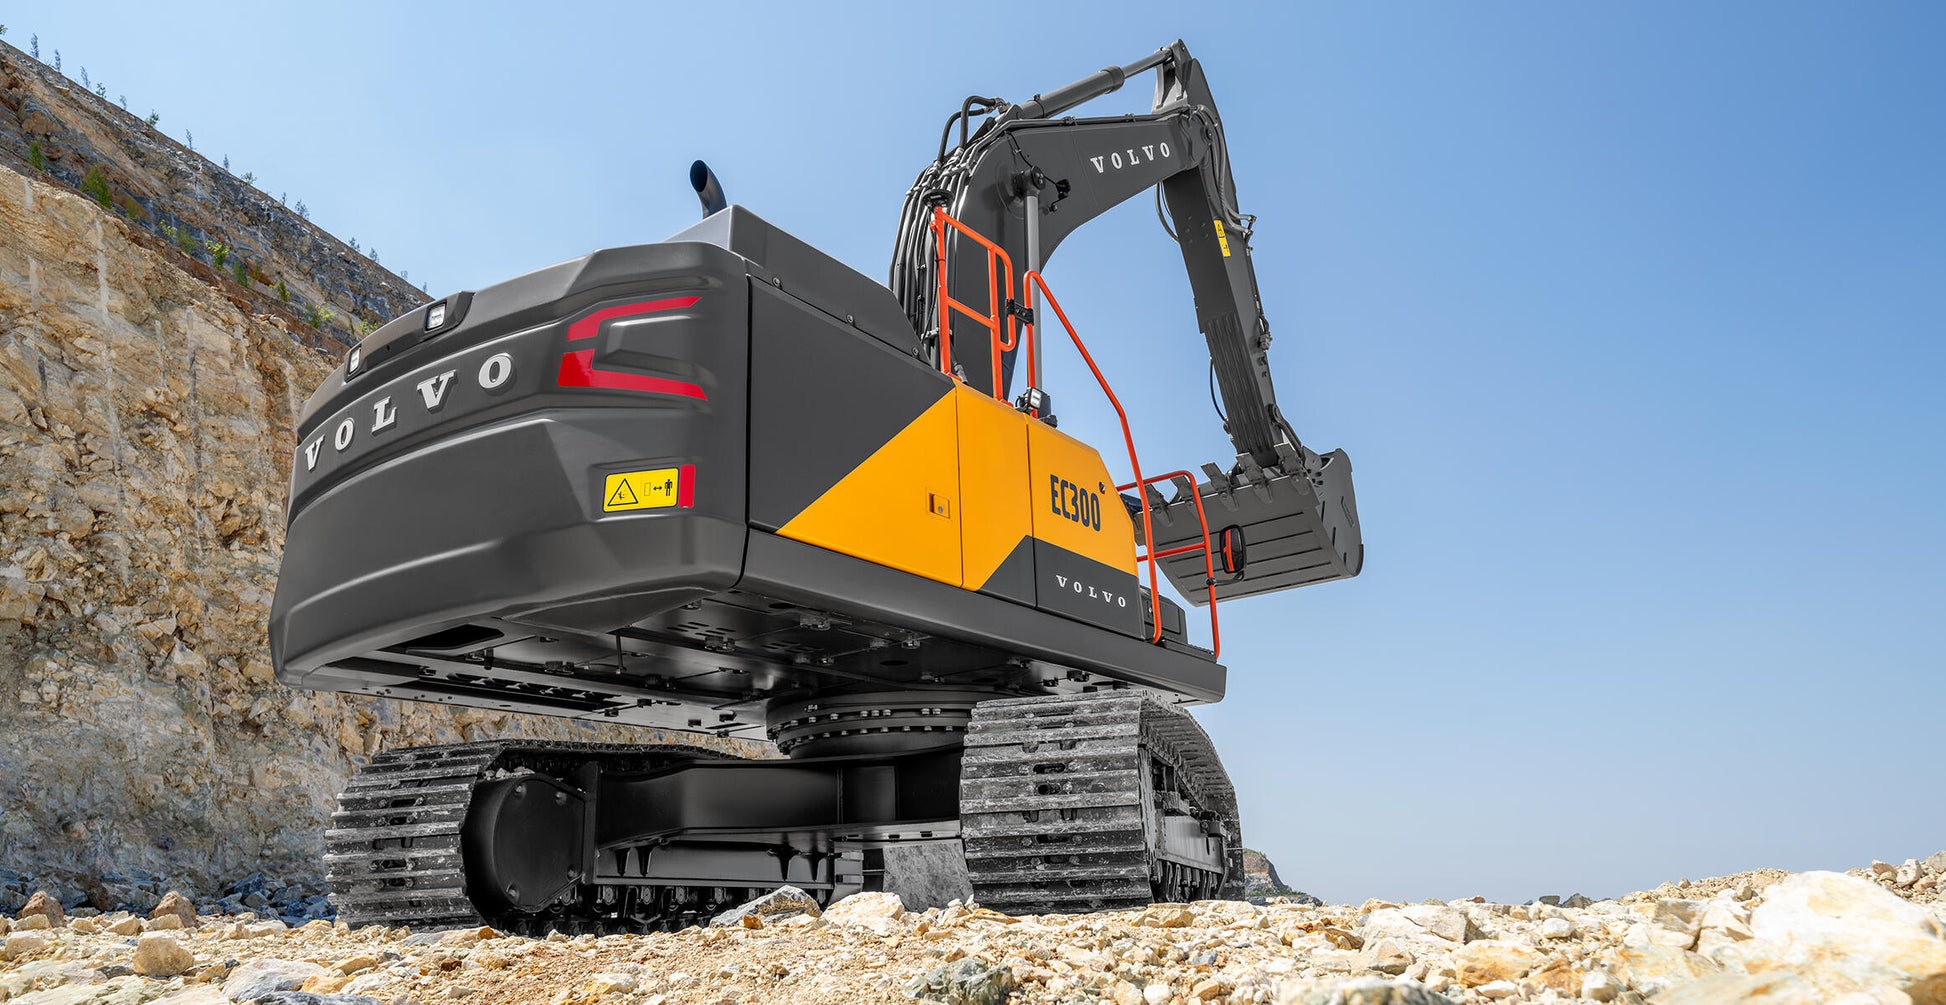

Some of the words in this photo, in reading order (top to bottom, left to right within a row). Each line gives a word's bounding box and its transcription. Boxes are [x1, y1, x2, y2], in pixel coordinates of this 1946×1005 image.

[1090, 142, 1170, 173] VOLVO
[305, 352, 513, 471] VOLVO
[1050, 474, 1101, 532] EC300
[1056, 574, 1126, 607] VOLVO
